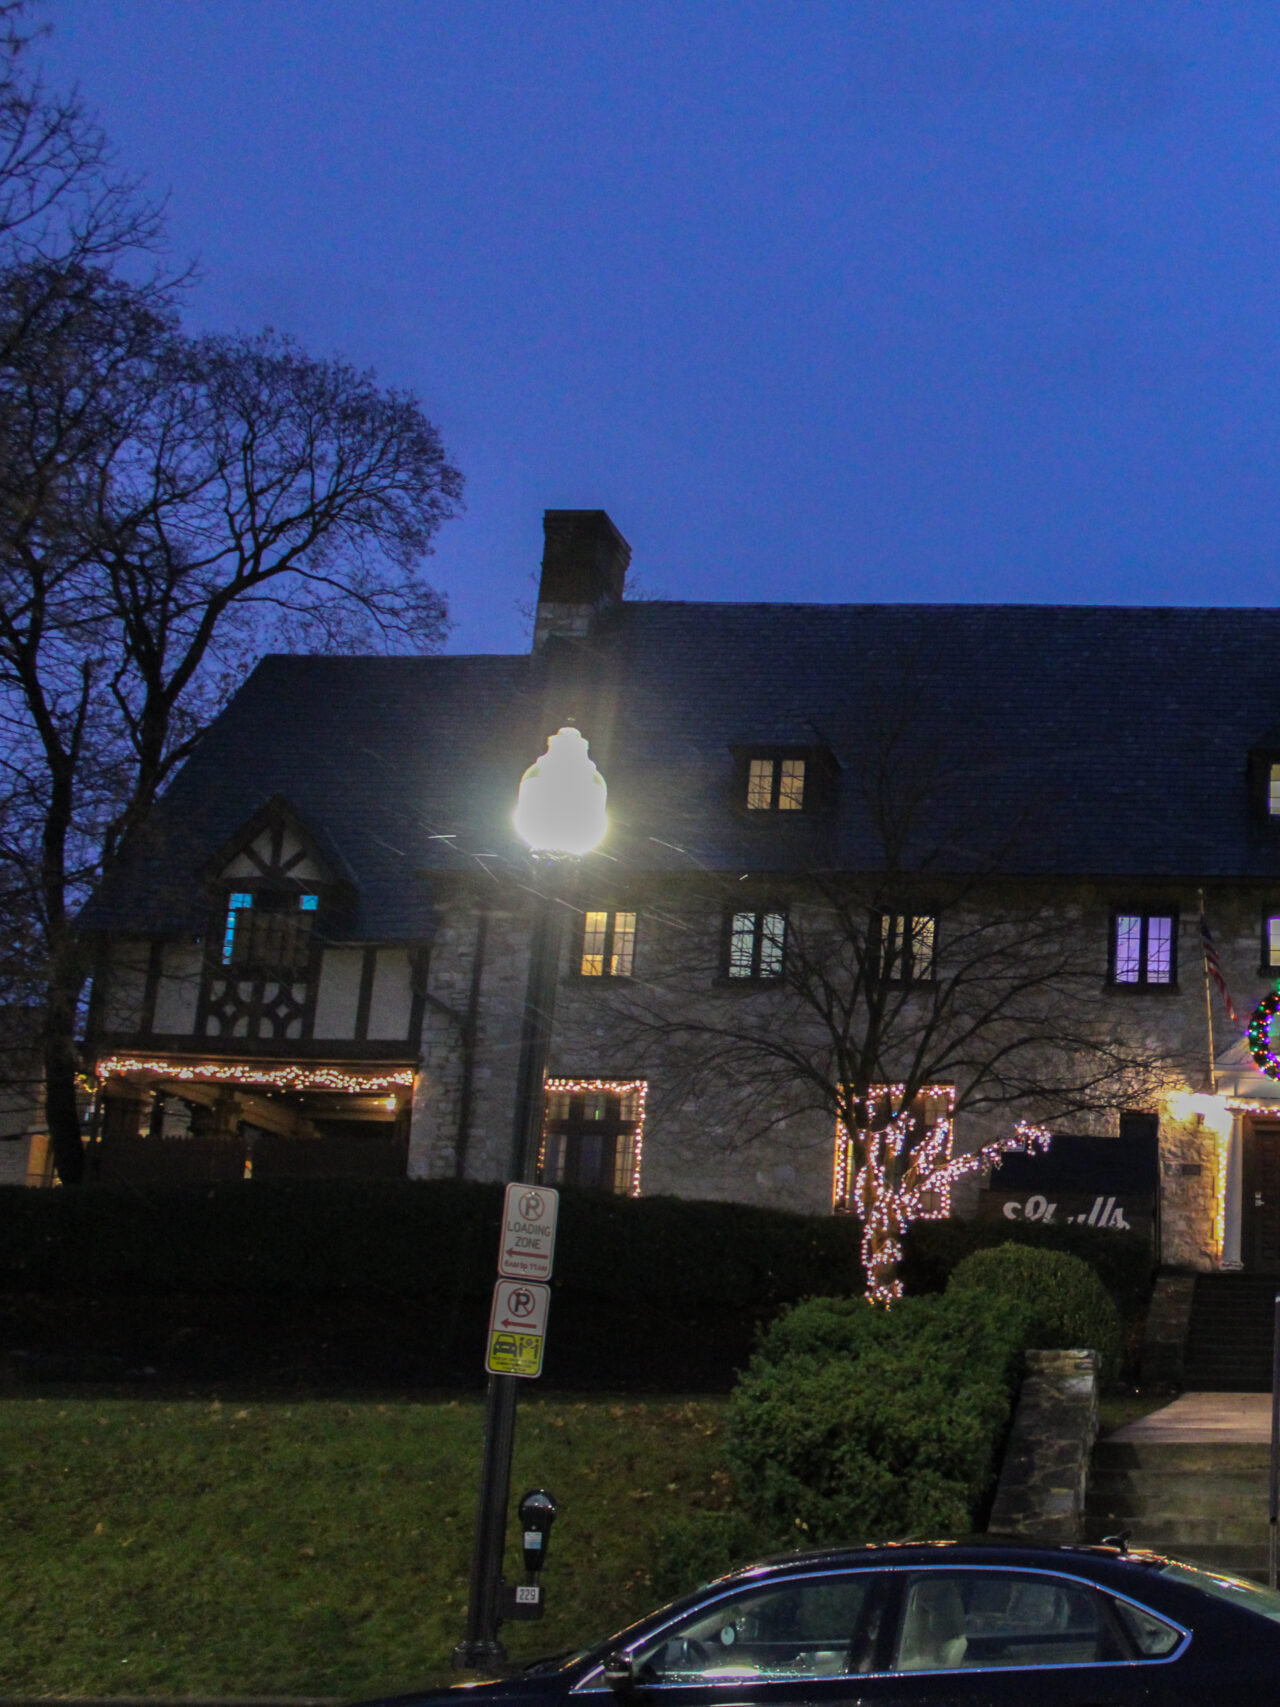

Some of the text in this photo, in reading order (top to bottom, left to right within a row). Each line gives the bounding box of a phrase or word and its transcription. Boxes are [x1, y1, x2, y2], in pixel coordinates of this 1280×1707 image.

[507, 1221, 551, 1237] LOADING
[514, 1236, 542, 1250] ZONE
[519, 1588, 536, 1601] 229
